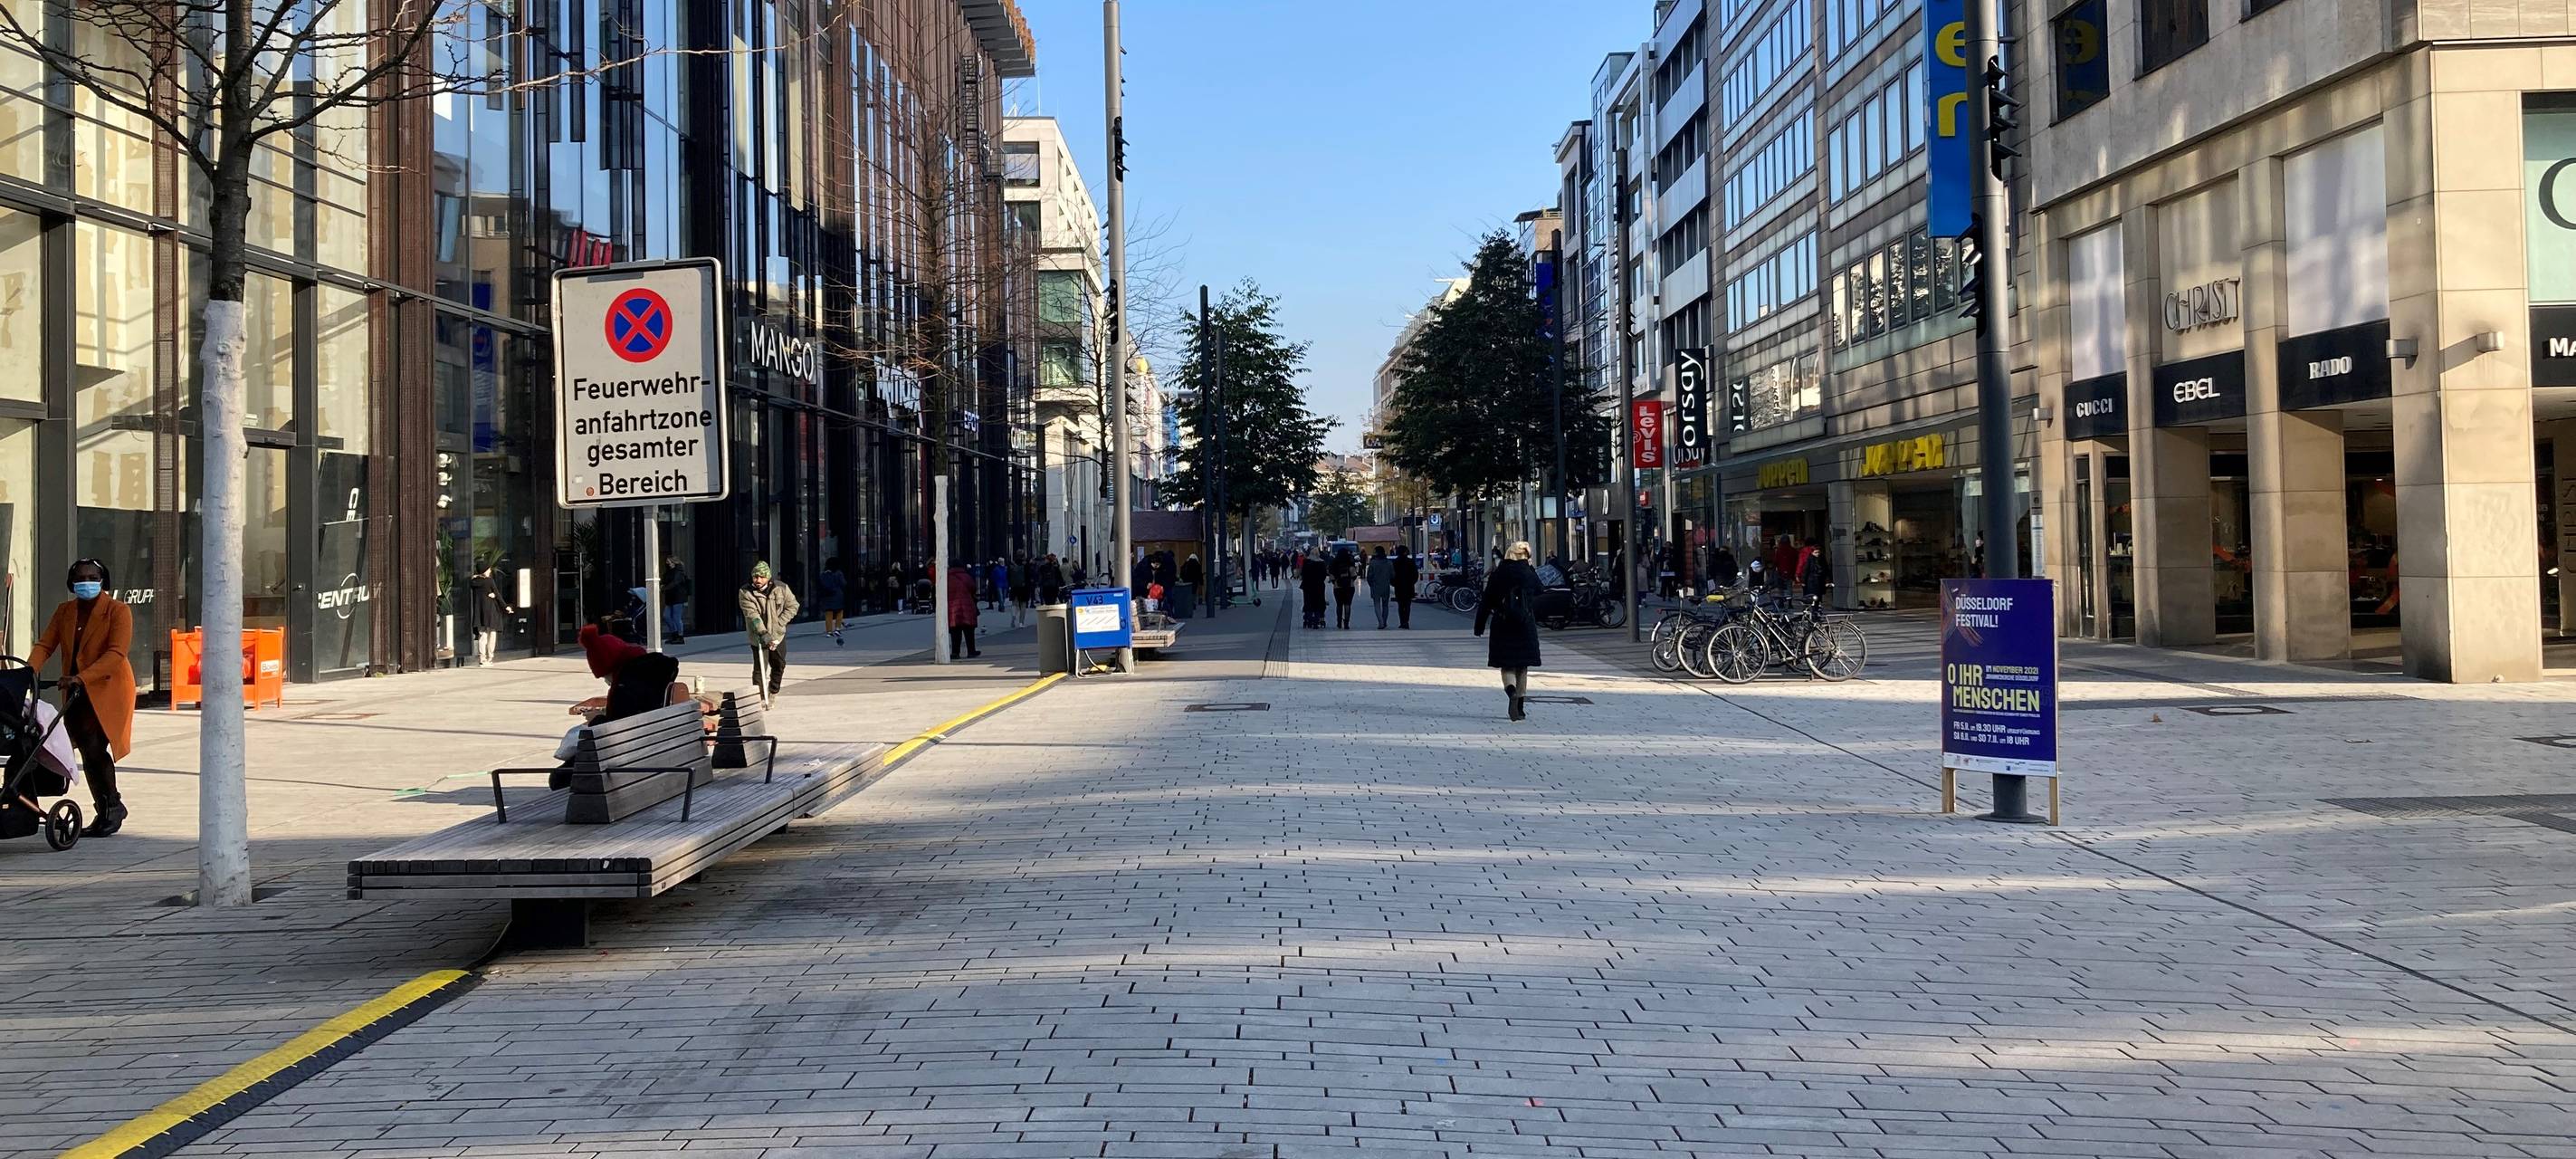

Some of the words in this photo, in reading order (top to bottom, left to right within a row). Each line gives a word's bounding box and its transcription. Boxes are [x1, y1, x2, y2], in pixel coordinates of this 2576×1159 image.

[2164, 277, 2240, 334] CHRIST
[751, 321, 815, 382] MANGO
[2309, 356, 2352, 379] RADO
[573, 371, 711, 401] Feuerwehr-
[1681, 350, 1703, 447] orsay
[2173, 377, 2221, 404] EBEL
[2075, 398, 2113, 418] GUCCI
[575, 409, 712, 436] anfahrtzone
[587, 436, 699, 467] gesamter
[598, 469, 688, 496] Bereich
[1955, 593, 2014, 611] DÜSSELDORF
[1955, 613, 1999, 627] FESTIVAL!
[1959, 664, 1983, 686] IHR
[1992, 666, 2024, 675] NOVEMBER
[2024, 666, 2039, 675] 2021
[1953, 685, 2040, 713] MENSCHEN
[1992, 724, 2007, 733] UHR
[2007, 735, 2014, 744] 18
[2014, 736, 2030, 746] UHR
